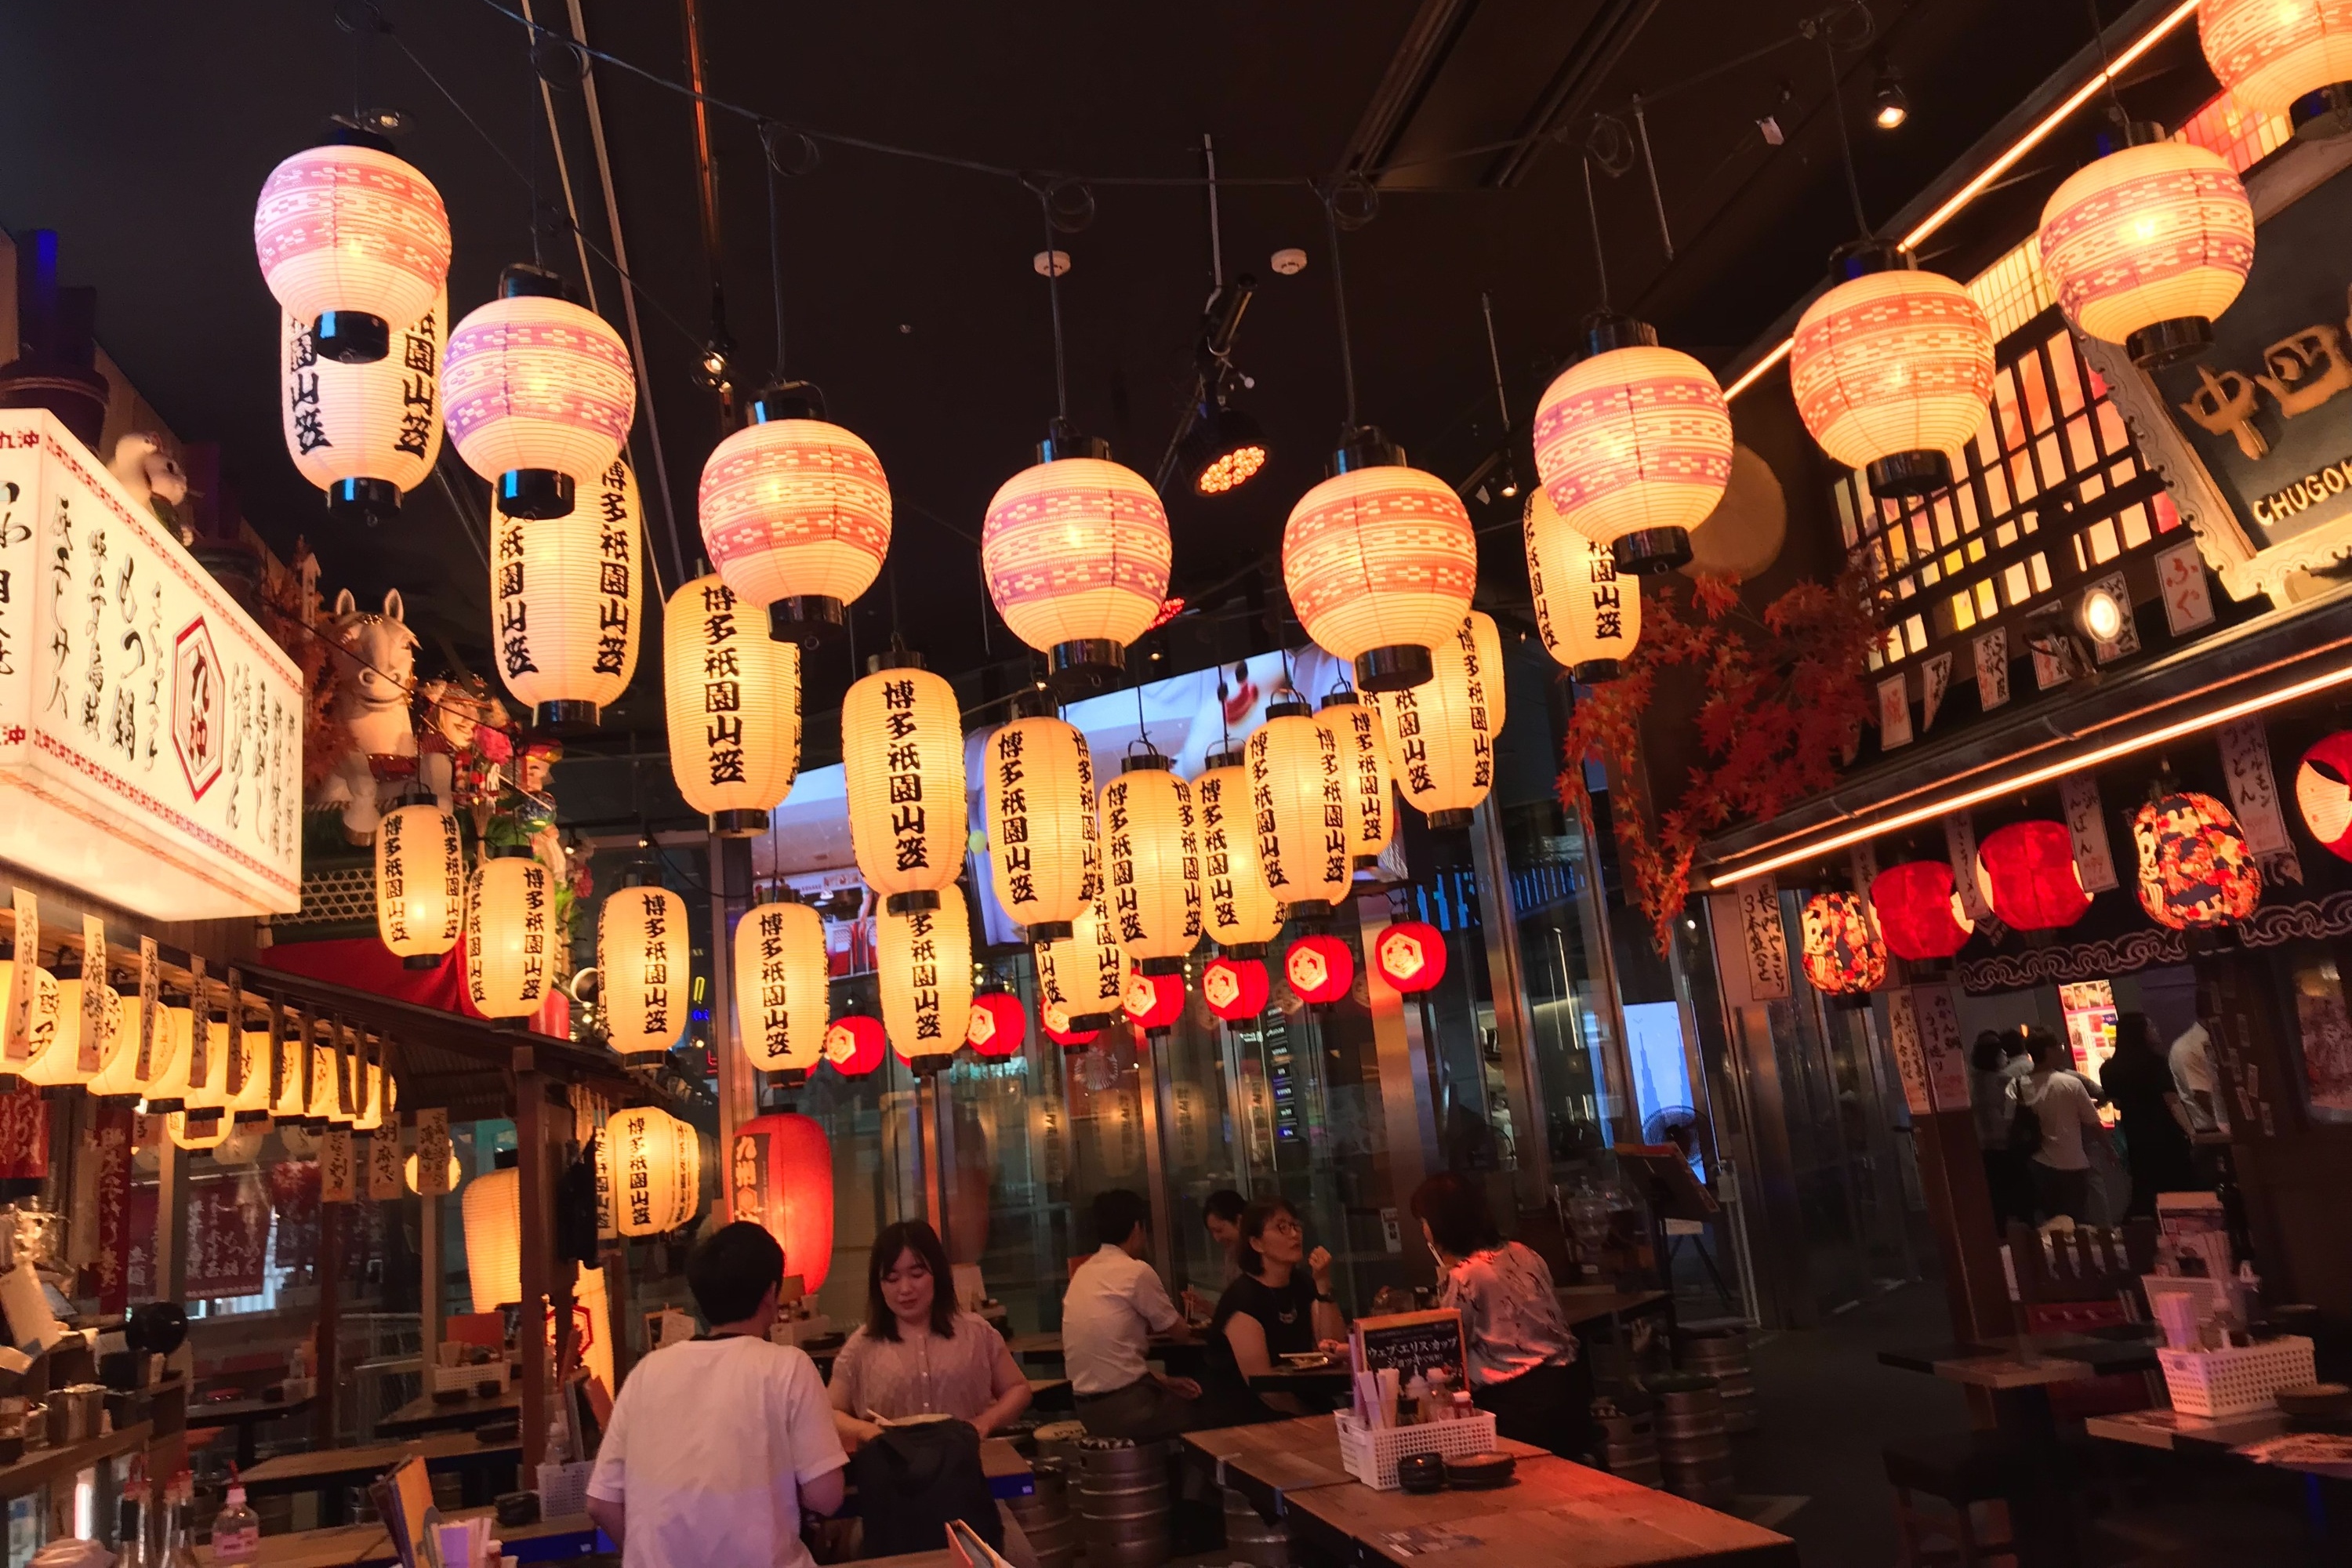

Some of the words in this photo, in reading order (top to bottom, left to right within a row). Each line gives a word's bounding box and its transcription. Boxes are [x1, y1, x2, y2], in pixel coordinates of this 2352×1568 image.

[107, 554, 145, 762] もつ鍋
[700, 586, 746, 786] 博多祇園山笠
[1456, 629, 1490, 788] 博多祇園山笠
[883, 680, 930, 871] 博多祇園山笠
[997, 730, 1039, 905] 博多祇園山笠
[1071, 729, 1097, 902] 博多祇園山笠
[1200, 779, 1240, 928] 博多祇園山笠
[1250, 730, 1290, 888] 博多祇園山笠
[1315, 728, 1346, 884] 博多祇園山笠
[1351, 712, 1381, 841] 博多祇園山笠
[383, 814, 411, 942] 博多祇園山笠
[440, 814, 460, 939] 博多祇園山笠
[520, 866, 546, 1001] 博多祇園山笠
[1106, 782, 1148, 942] 博多祇園山笠
[641, 893, 669, 1035] 博多祇園山笠
[758, 913, 793, 1059] 博多祇園山笠
